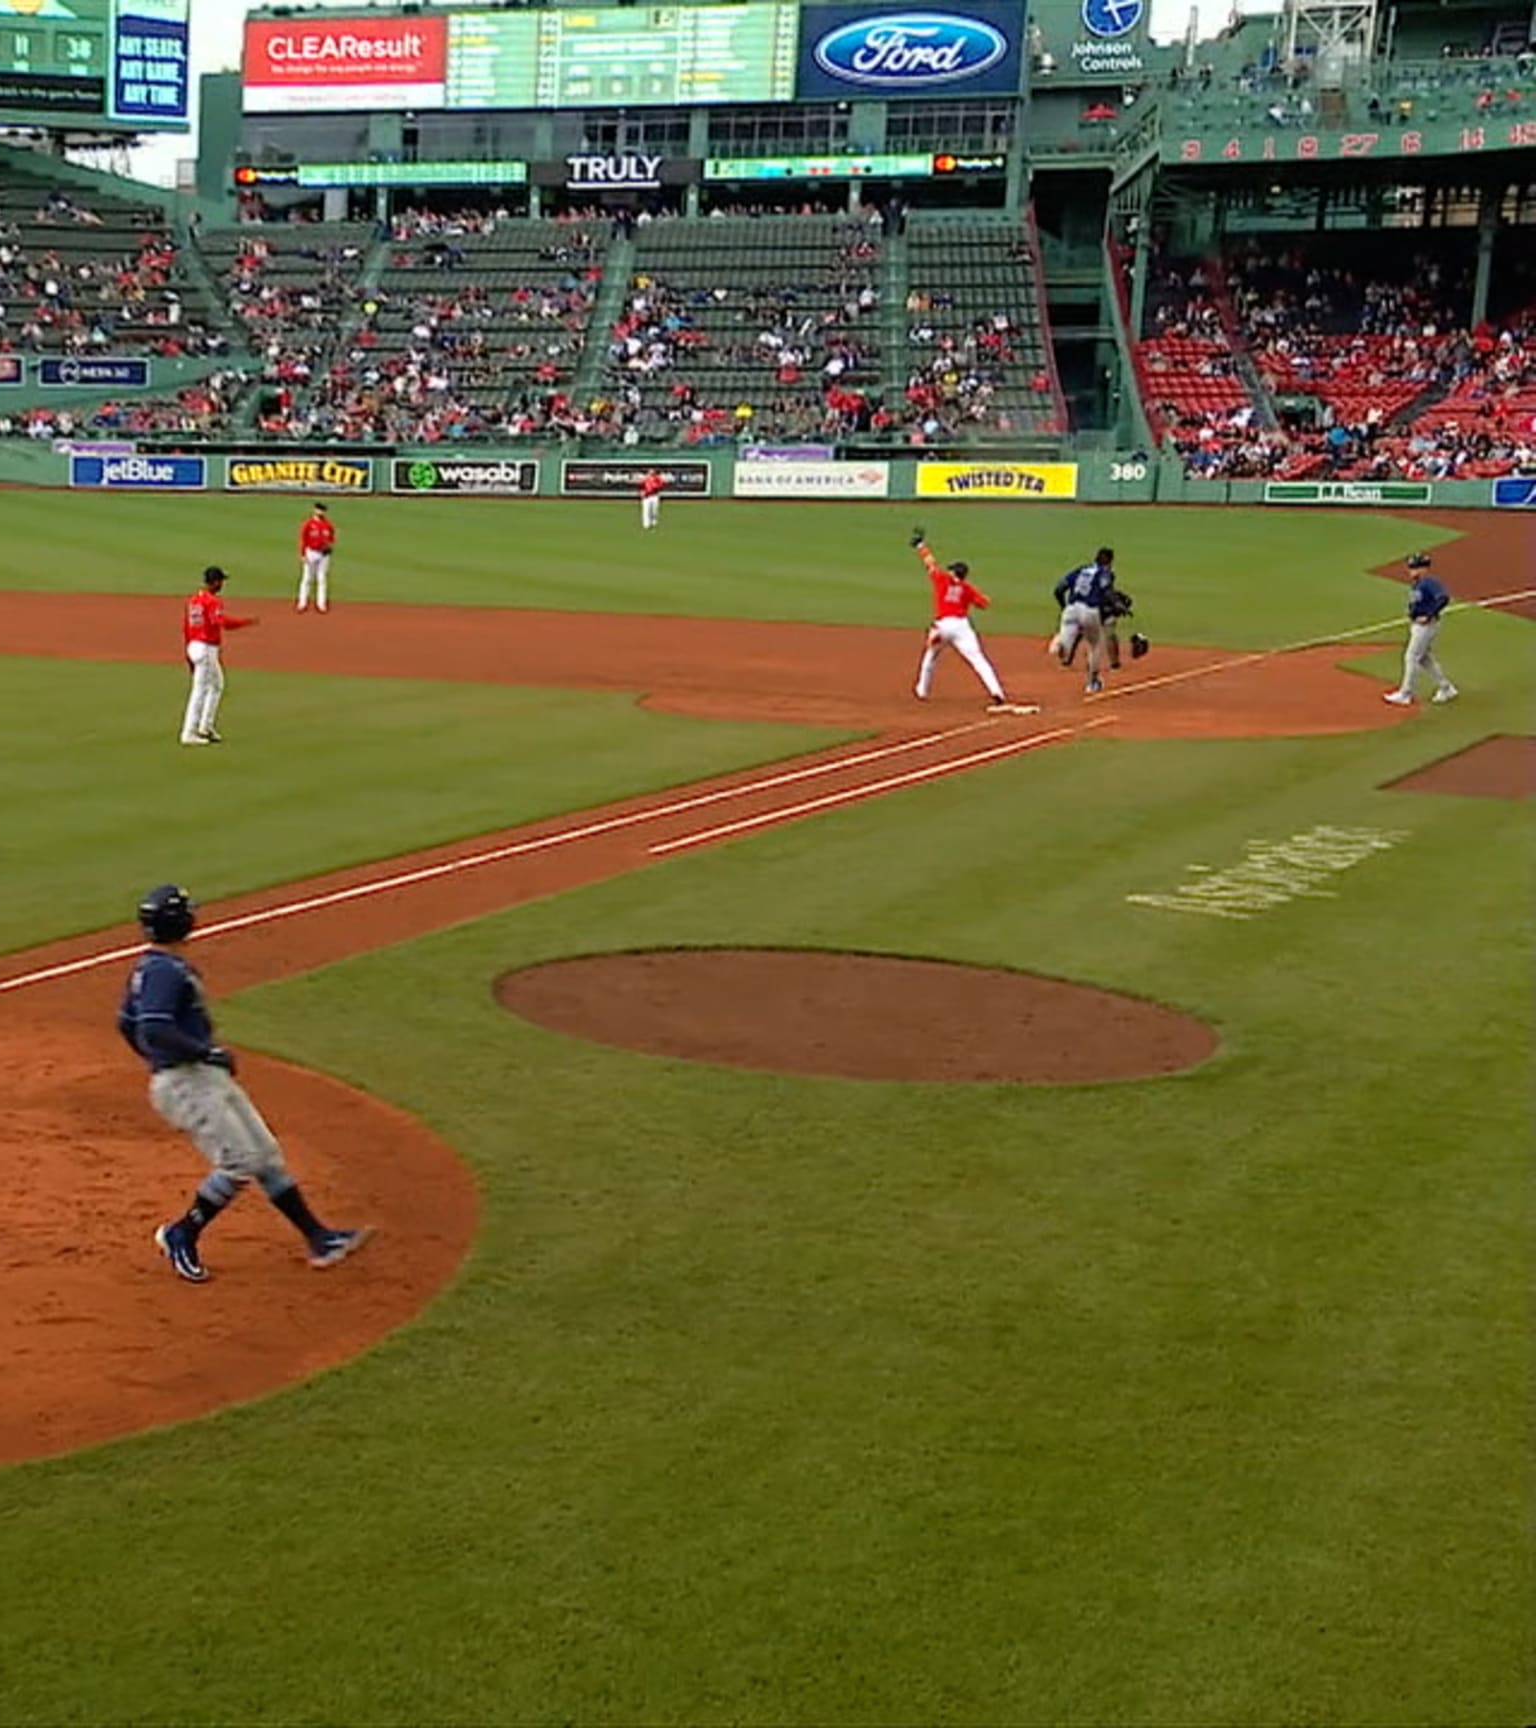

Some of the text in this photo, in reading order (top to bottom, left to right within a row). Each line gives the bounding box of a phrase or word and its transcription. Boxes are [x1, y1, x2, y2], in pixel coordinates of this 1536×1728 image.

[267, 33, 422, 60] CLEAResult
[853, 25, 966, 71] Ford
[1070, 40, 1132, 59] Johnson
[1081, 55, 1143, 71] Controls
[1223, 138, 1241, 159] 4
[1340, 132, 1379, 157] 27
[566, 156, 660, 181] TRULY
[101, 459, 174, 484] jetBlue
[231, 461, 366, 486] GRANITE CITY
[439, 464, 520, 483] wasabi
[739, 475, 772, 484] BANK
[795, 474, 854, 485] AMERICA
[946, 471, 1046, 493] TWISTED TEA
[1111, 463, 1146, 480] 380
